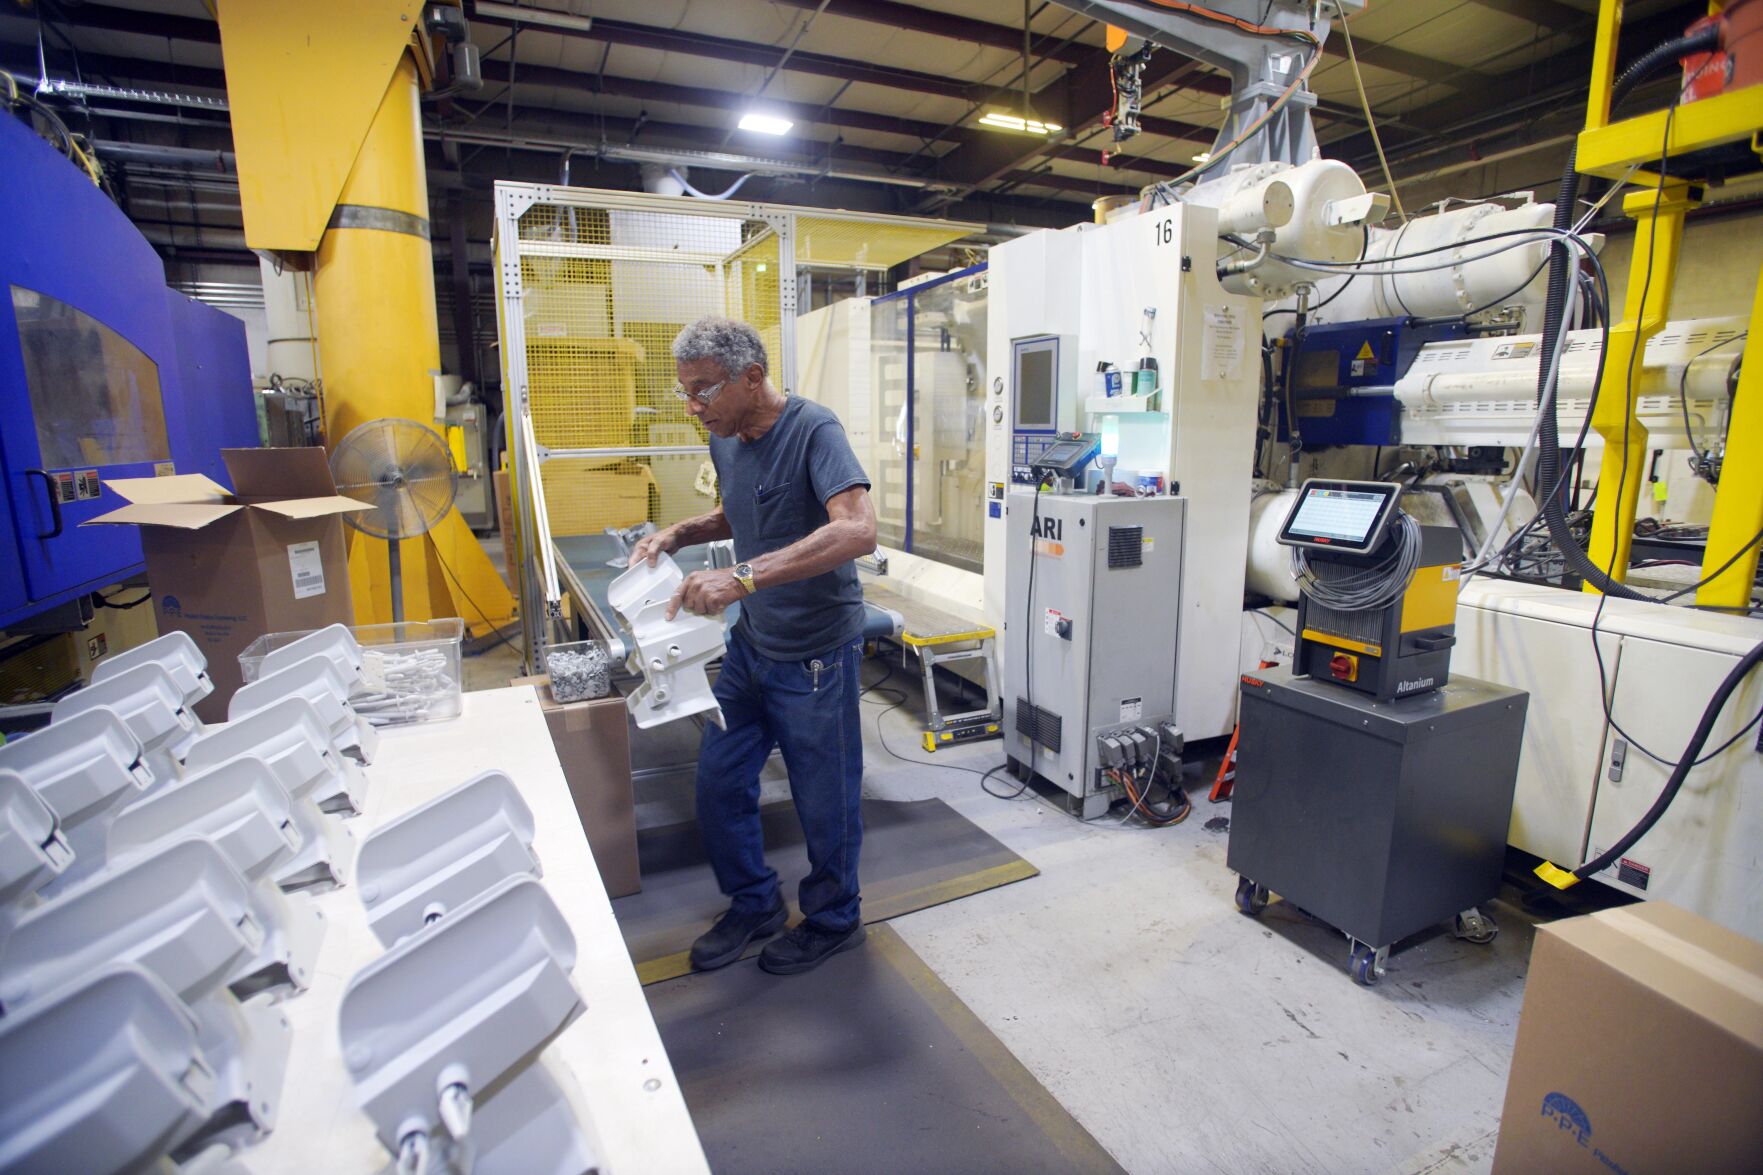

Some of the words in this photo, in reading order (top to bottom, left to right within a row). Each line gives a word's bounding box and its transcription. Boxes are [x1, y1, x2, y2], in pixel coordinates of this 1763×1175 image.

[1155, 218, 1172, 246] 16
[1030, 515, 1062, 541] ARI
[1241, 674, 1265, 688] HUSKY
[1397, 677, 1434, 694] Altanium
